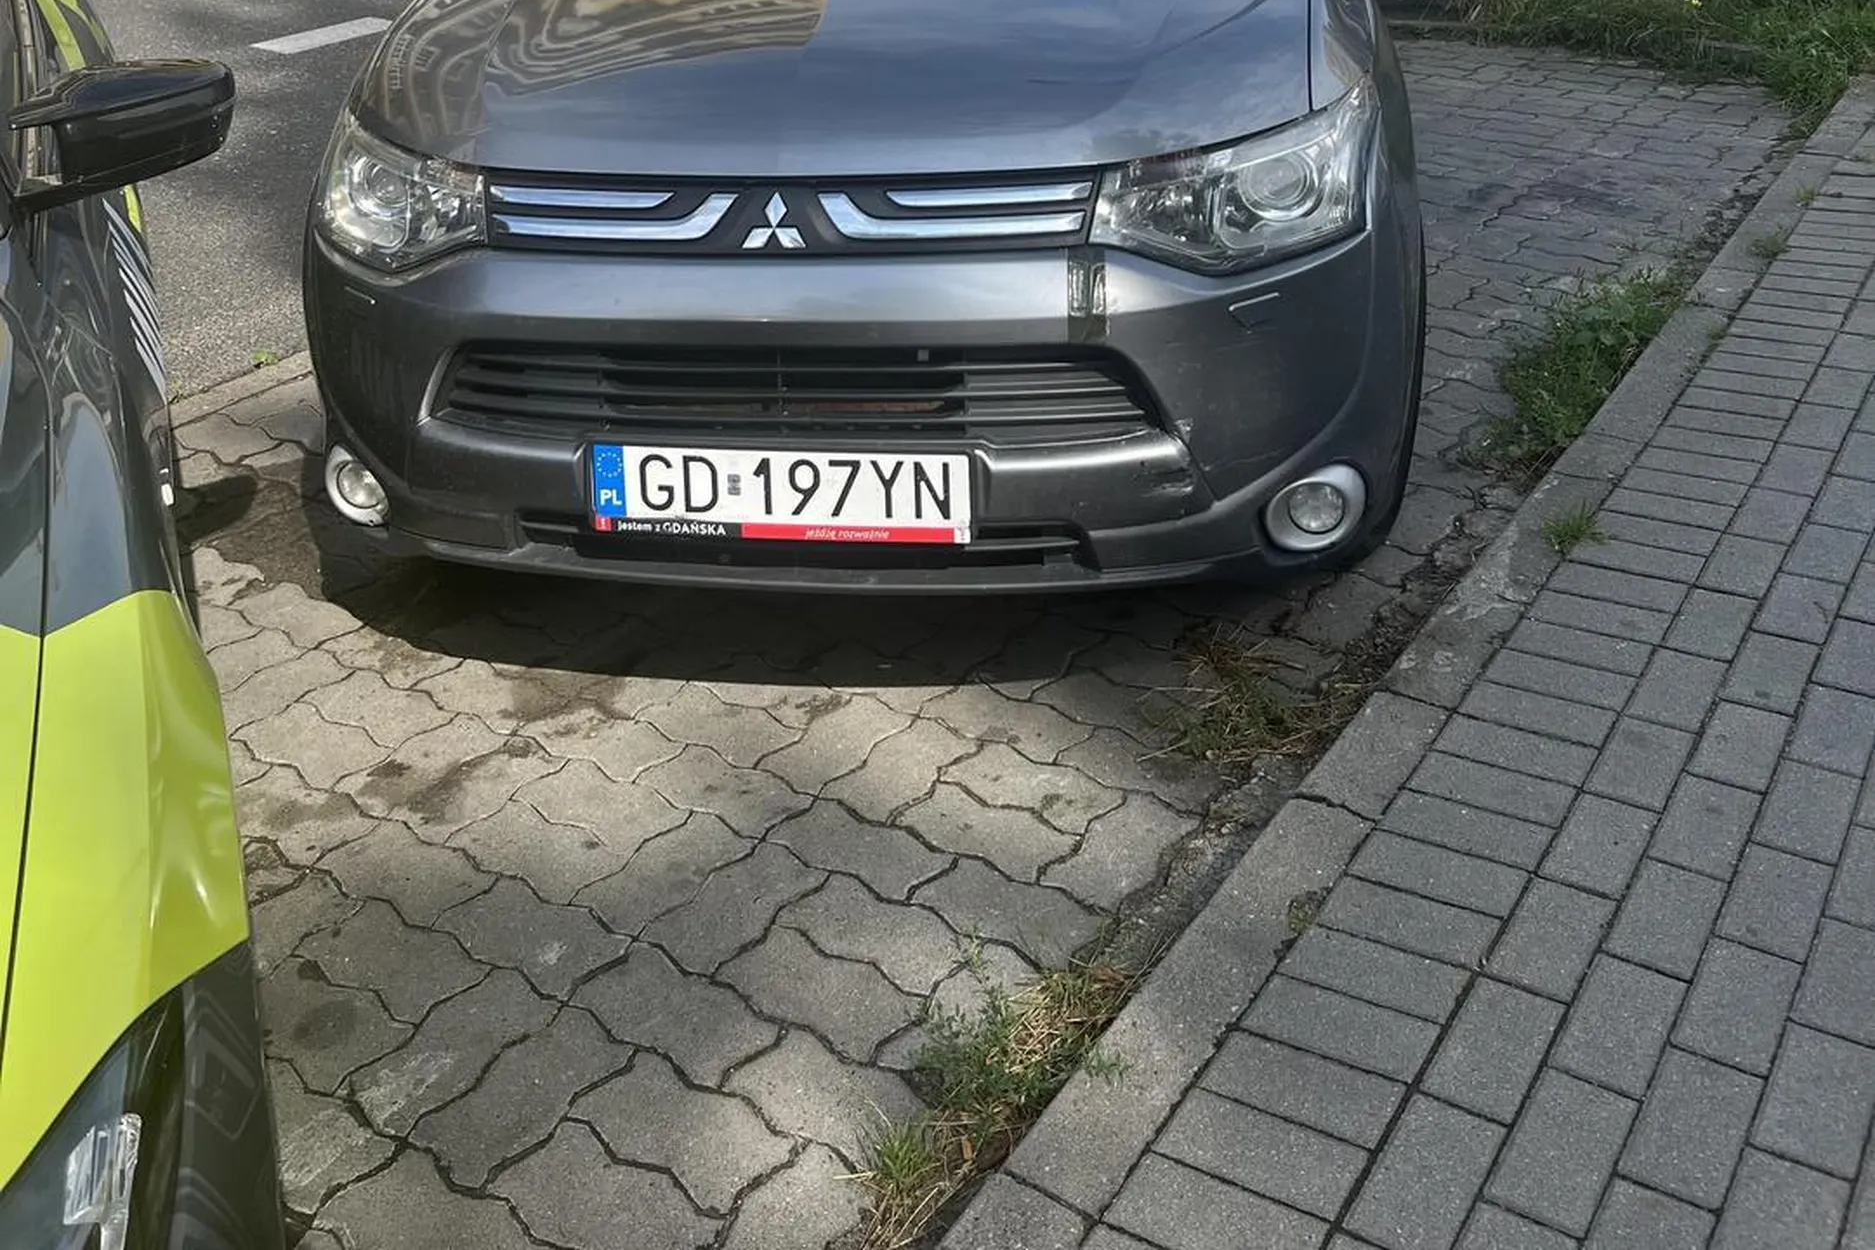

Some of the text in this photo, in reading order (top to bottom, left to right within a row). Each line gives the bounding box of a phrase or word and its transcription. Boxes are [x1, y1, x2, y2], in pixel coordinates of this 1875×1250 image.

[639, 454, 951, 519] GD 197YN
[601, 490, 622, 506] PL
[663, 523, 726, 535] GDAŃSKA
